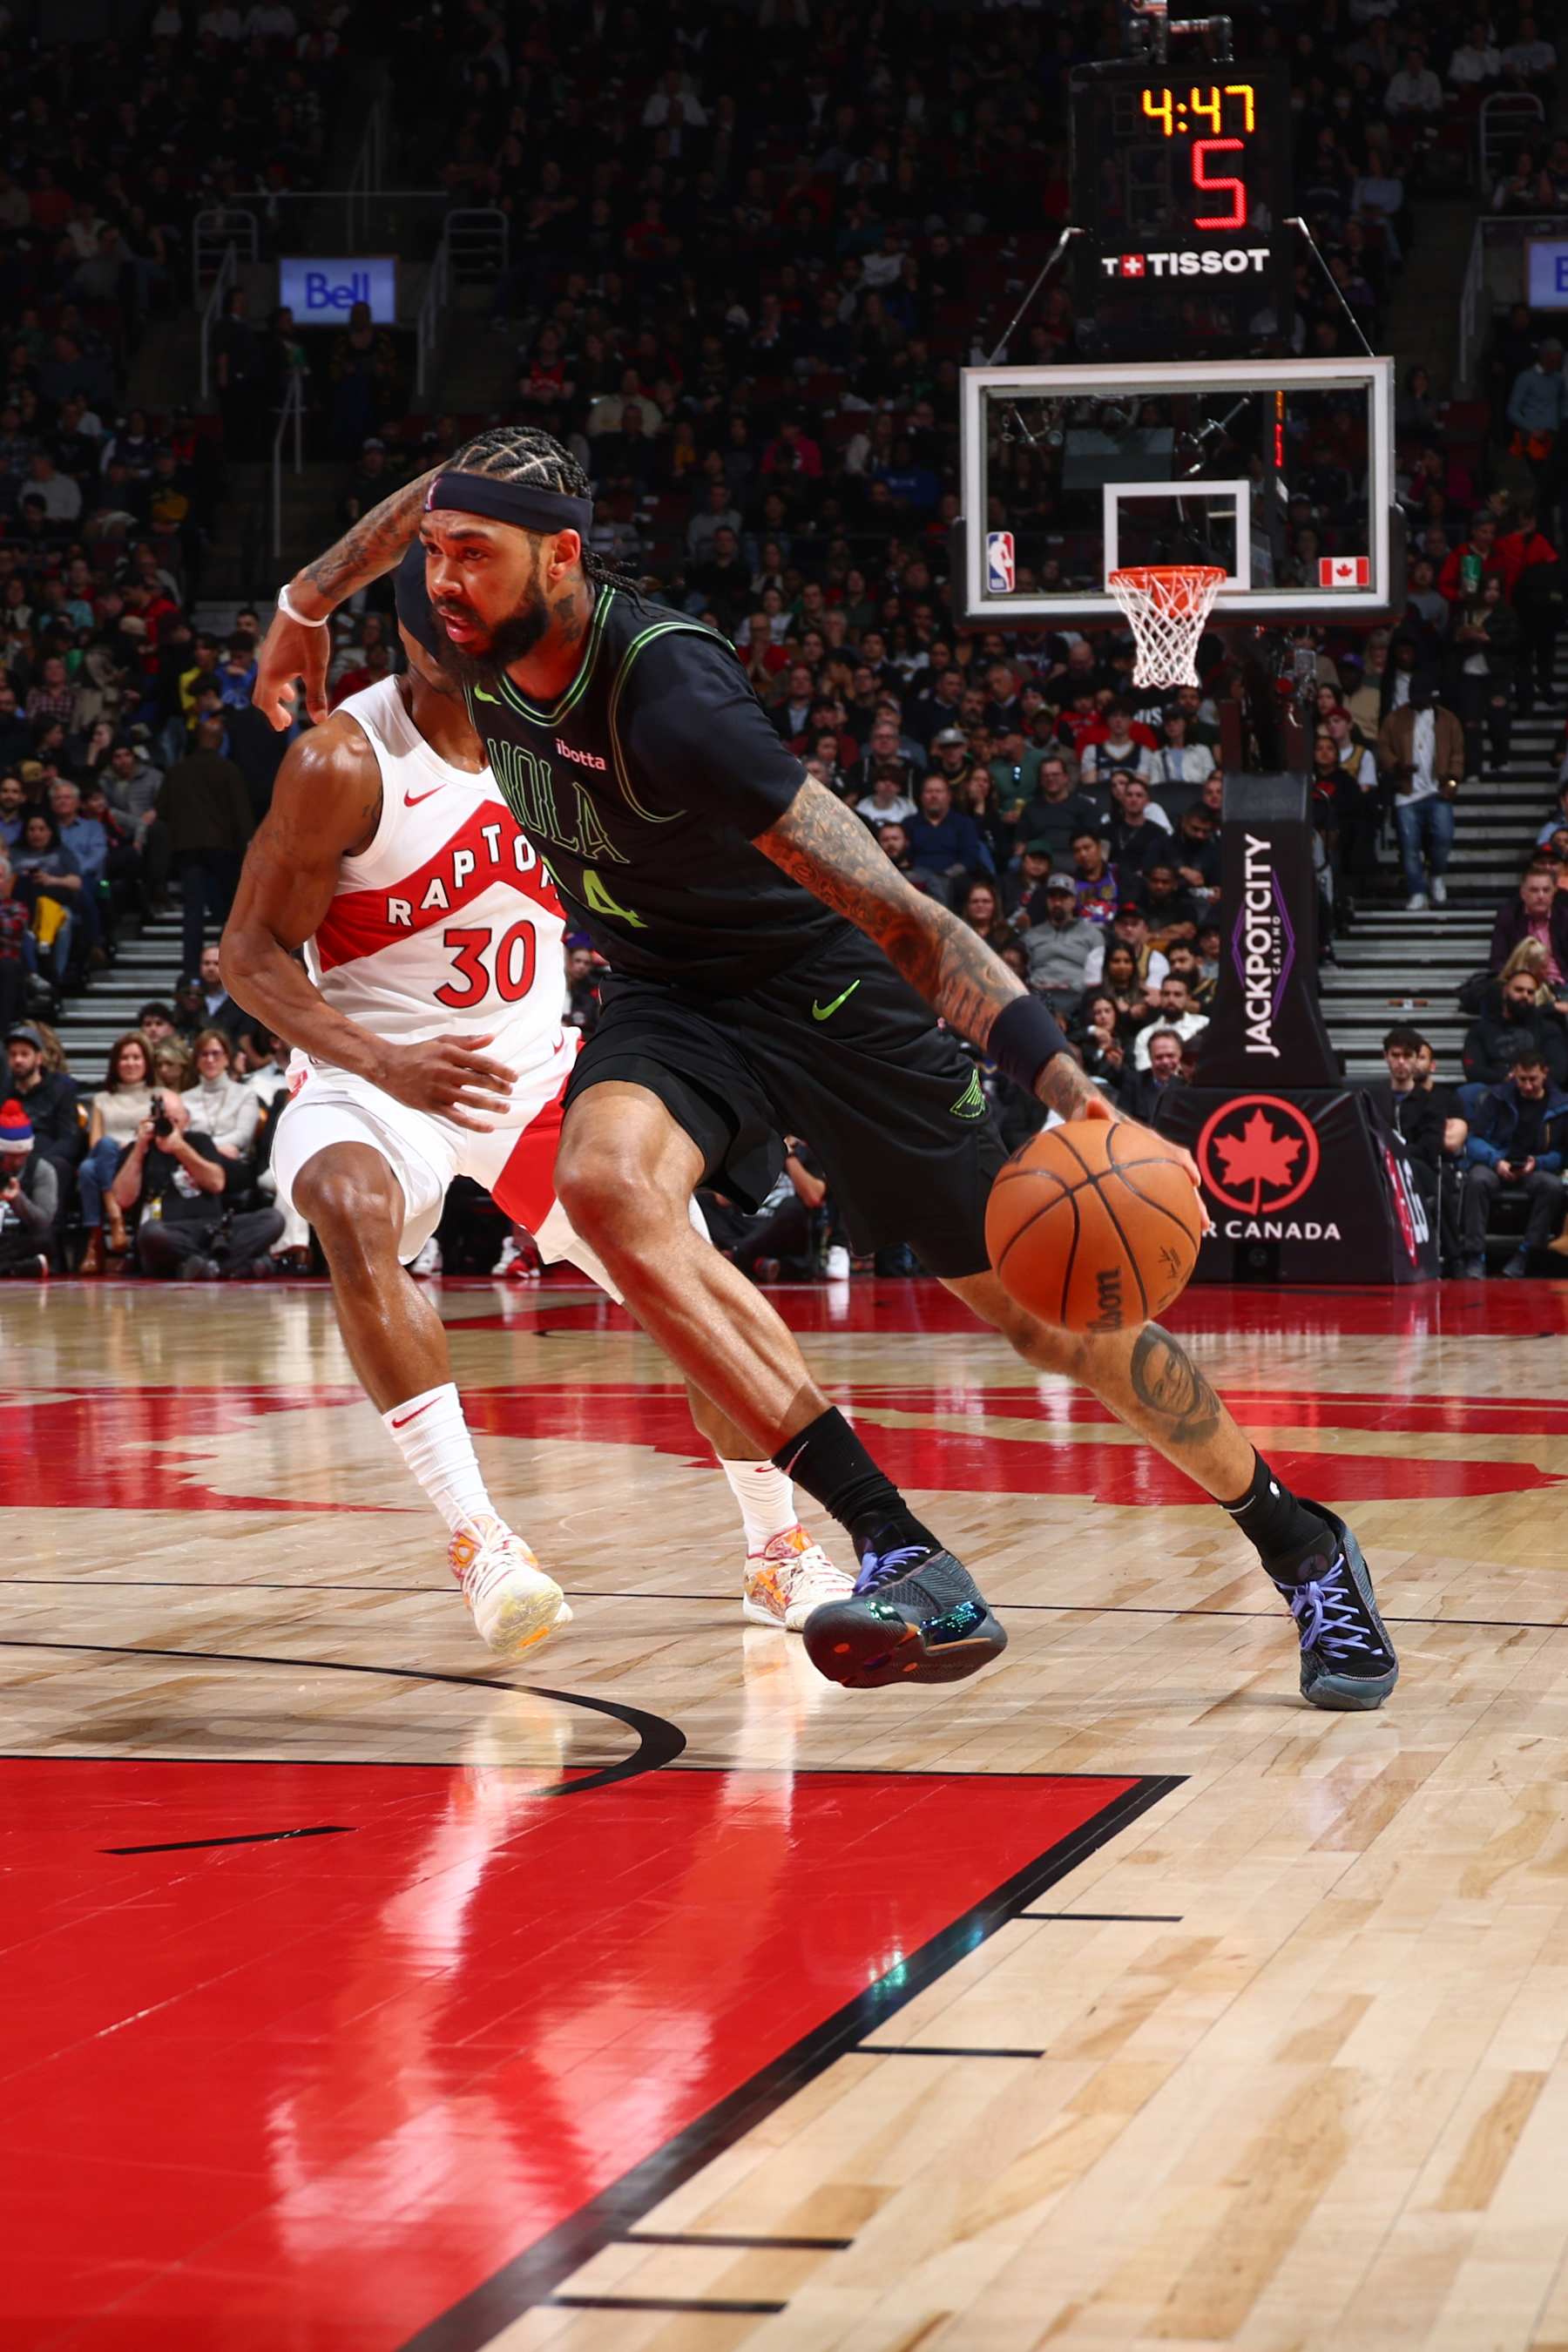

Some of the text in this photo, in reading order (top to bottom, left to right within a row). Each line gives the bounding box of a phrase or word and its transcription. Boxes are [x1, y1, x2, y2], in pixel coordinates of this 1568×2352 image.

[1143, 84, 1255, 136] 4:47
[1193, 139, 1246, 230] 5
[306, 271, 370, 308] Bell
[1146, 248, 1270, 276] TISSOT
[555, 738, 606, 771] ibotta
[387, 823, 559, 927] RAPTO
[581, 869, 649, 928] 4
[433, 919, 537, 1009] 30
[1245, 833, 1281, 1058] JACKPOTCITY
[1272, 916, 1282, 976] CASINO
[1225, 1220, 1342, 1240] CANADA
